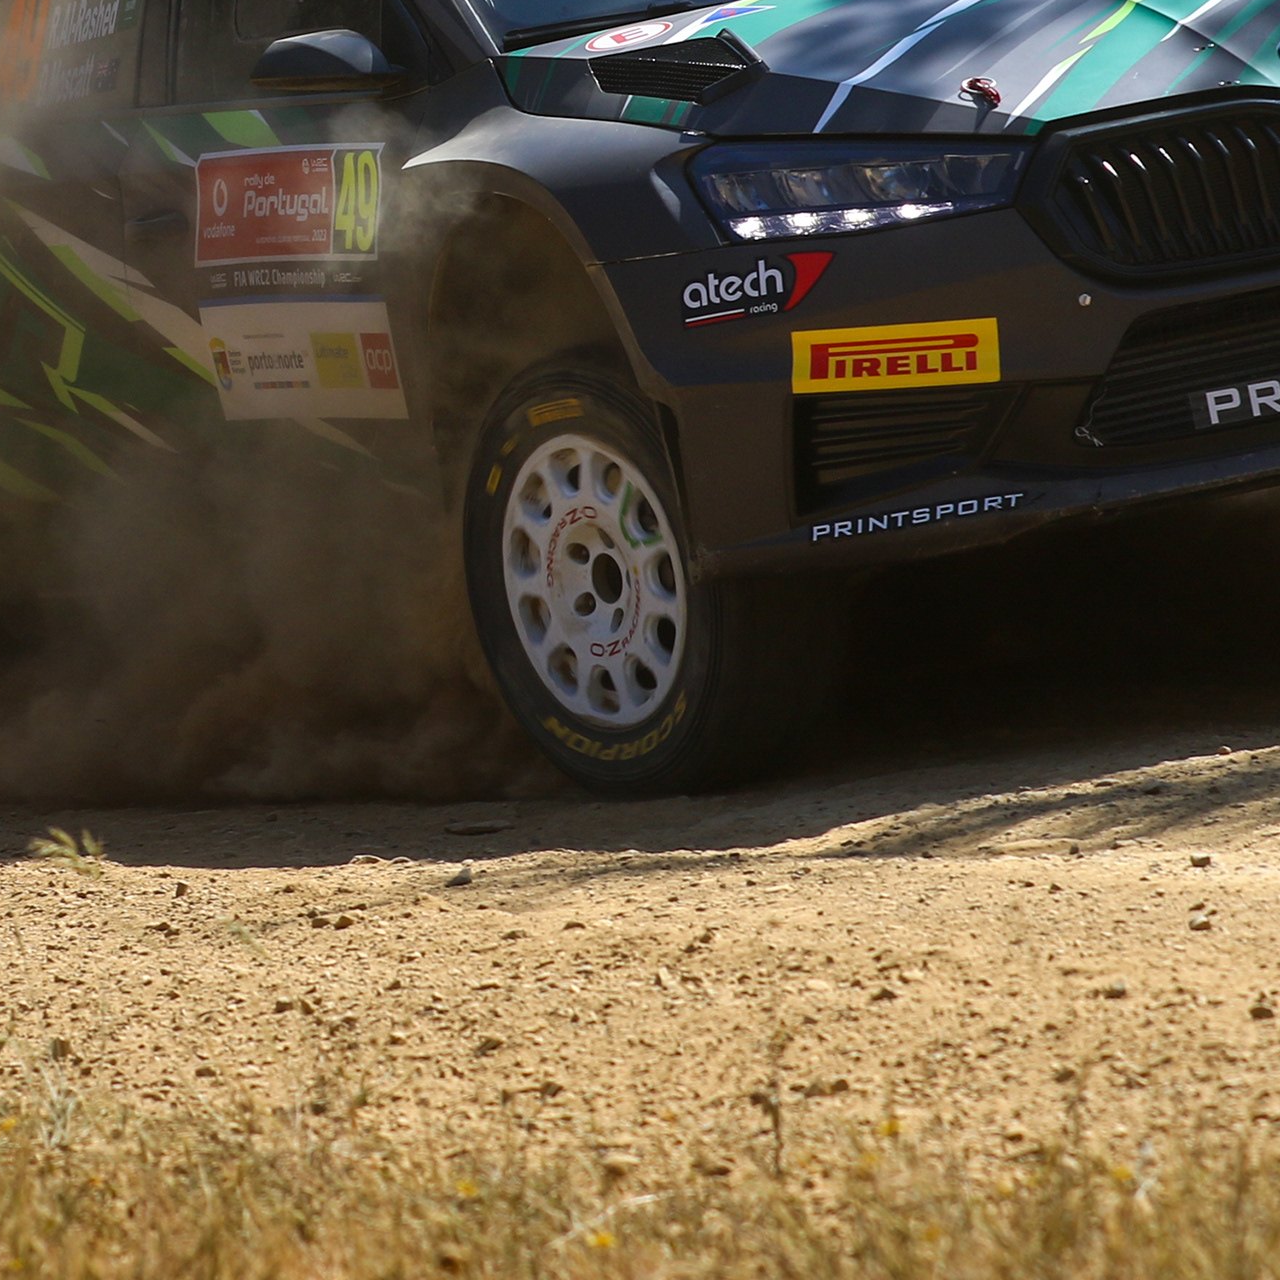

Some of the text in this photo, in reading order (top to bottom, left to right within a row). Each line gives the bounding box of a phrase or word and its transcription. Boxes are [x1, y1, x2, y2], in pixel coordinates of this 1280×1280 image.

[244, 173, 276, 189] rally de
[243, 186, 330, 222] Portugal
[335, 150, 379, 252] 49
[203, 222, 236, 239] vodafone
[234, 269, 327, 288] FIA WRC2 Championship
[683, 259, 784, 309] atech
[749, 301, 779, 315] racing
[366, 348, 393, 375] acp
[810, 333, 979, 380] PIRELLI
[811, 493, 1024, 542] PRINTSPORT
